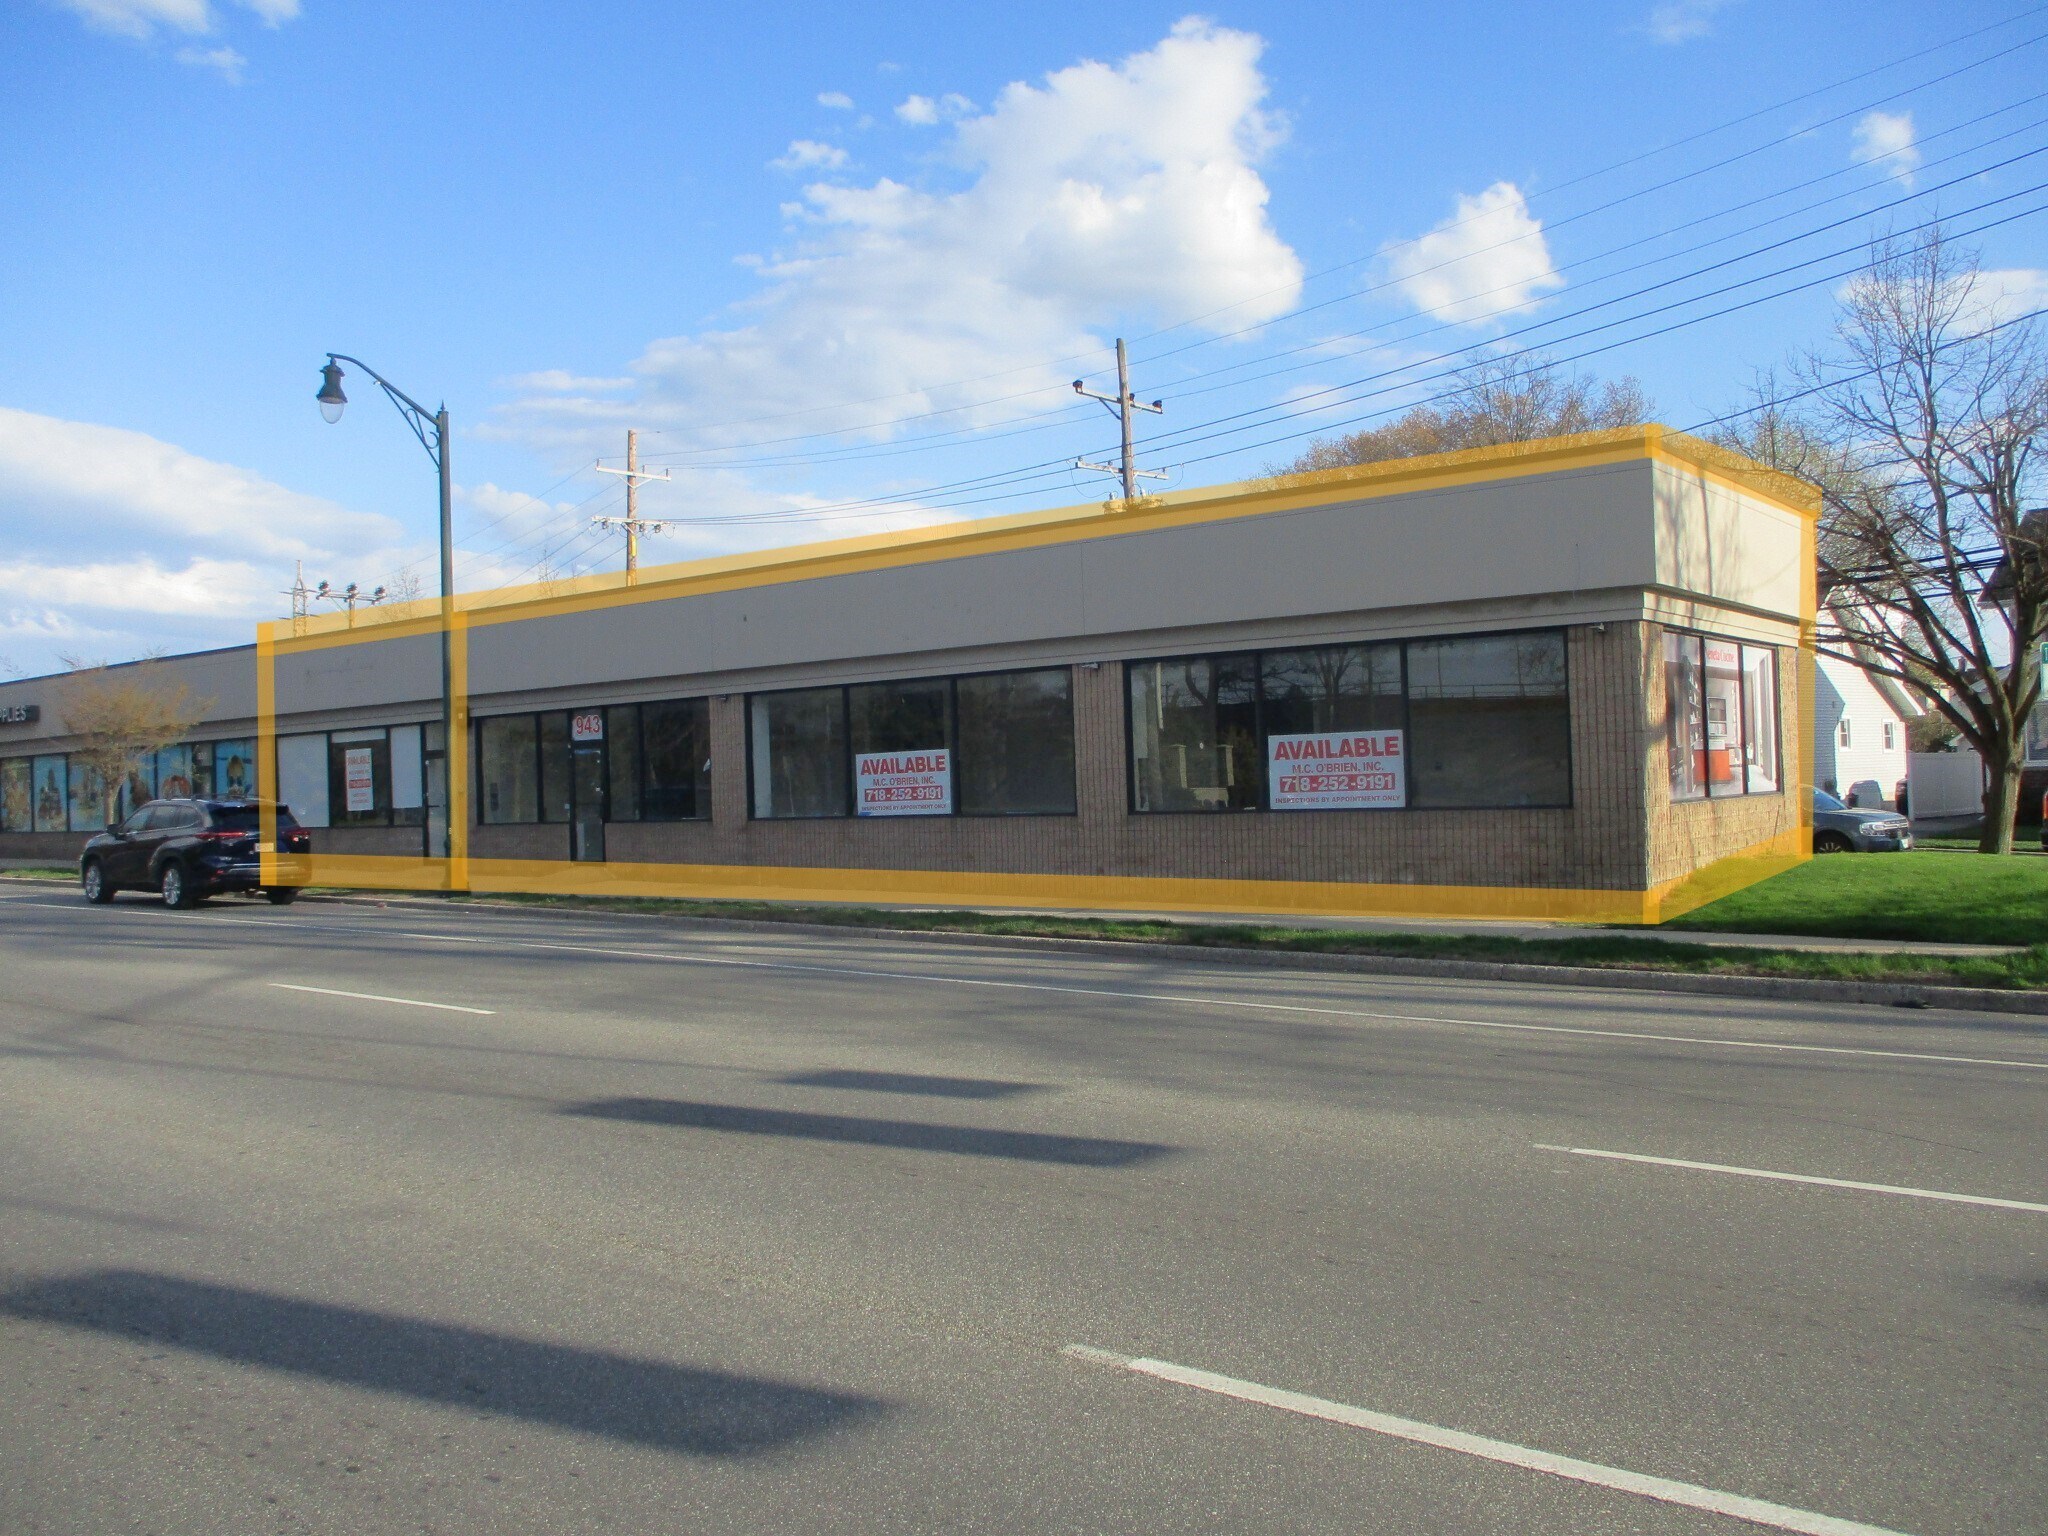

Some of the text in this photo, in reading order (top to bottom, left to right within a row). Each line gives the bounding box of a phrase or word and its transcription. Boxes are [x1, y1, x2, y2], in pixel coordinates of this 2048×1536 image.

[576, 715, 600, 735] 943
[1274, 736, 1401, 761] AVAILABLE
[861, 754, 946, 776] AVAILABLE
[1292, 764, 1313, 774] M.C.
[1363, 761, 1384, 771] INC.
[873, 778, 888, 787] M.C.
[921, 775, 936, 785] INC.
[1282, 774, 1393, 793] 718-252-9191
[865, 787, 942, 802] 718-252-9191
[1331, 795, 1380, 803] APPOINTMENT
